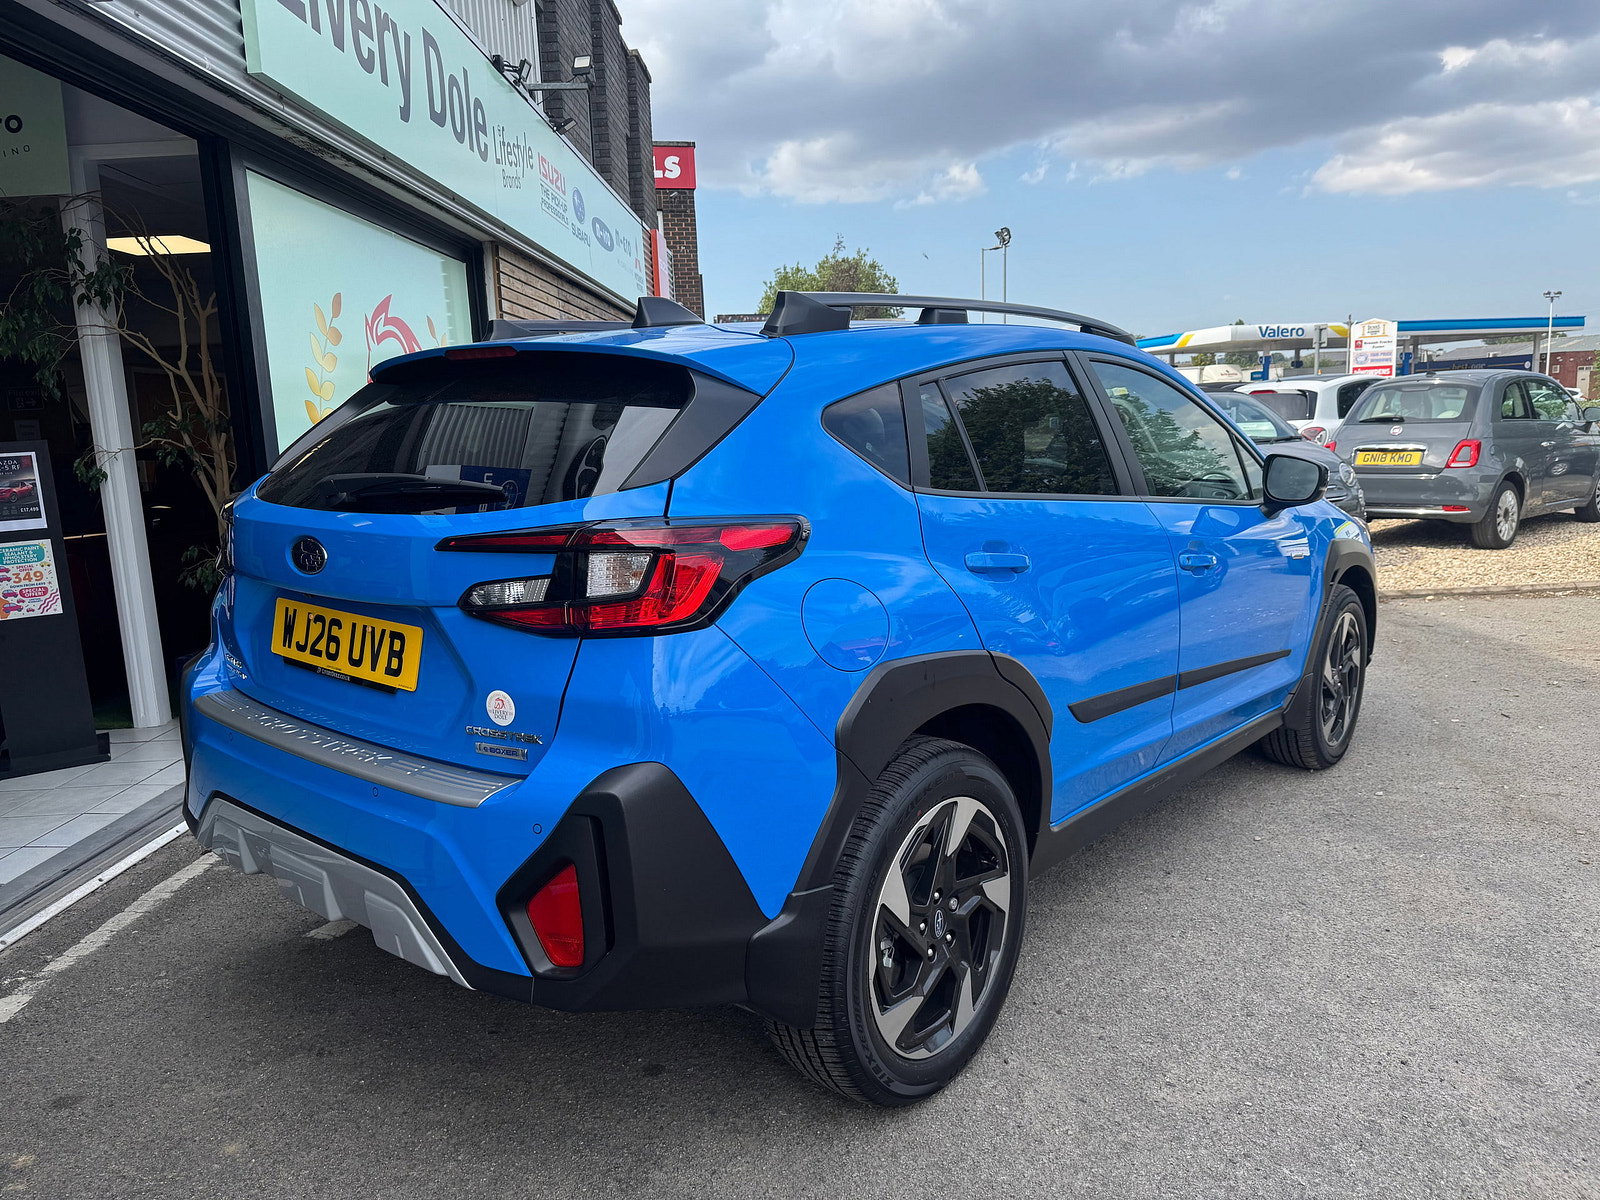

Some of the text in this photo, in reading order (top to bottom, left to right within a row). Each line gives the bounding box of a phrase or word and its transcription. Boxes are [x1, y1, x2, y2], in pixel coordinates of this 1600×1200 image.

[422, 26, 489, 163] Dole
[492, 125, 534, 178] Lifestyle
[502, 169, 522, 189] Brands
[538, 152, 566, 196] ISUZU
[571, 222, 591, 247] SUBARU
[1258, 326, 1305, 338] Valero
[1362, 453, 1413, 463] GN18 KMO
[12, 570, 44, 584] 349
[282, 606, 406, 678] WJ26 UVB
[465, 725, 543, 745] CROSSTREK
